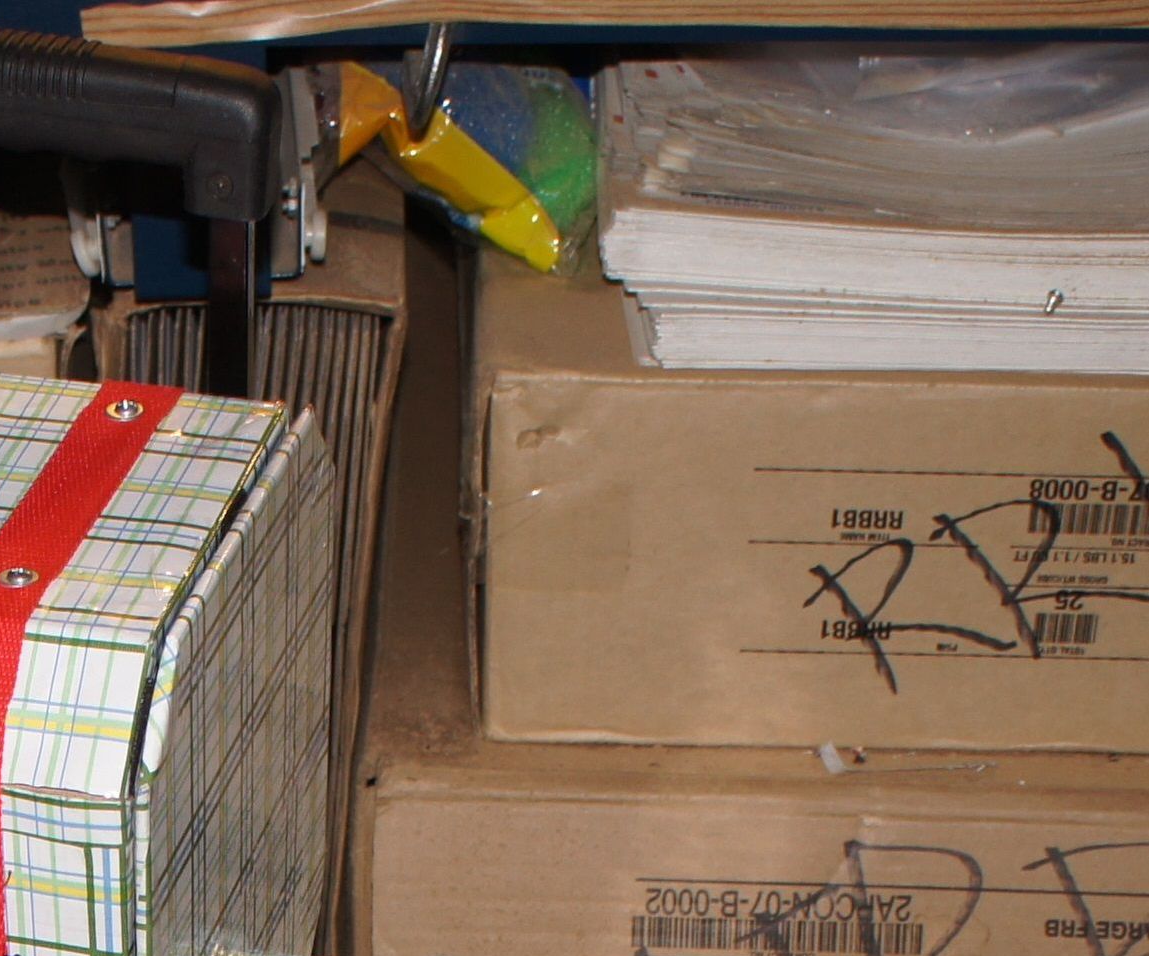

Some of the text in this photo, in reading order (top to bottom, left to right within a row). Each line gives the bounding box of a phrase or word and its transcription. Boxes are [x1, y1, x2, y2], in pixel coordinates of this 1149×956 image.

[831, 510, 904, 530] RRBB1
[1013, 551, 1029, 562] FT
[1051, 551, 1073, 562] 1.1
[1083, 551, 1108, 563] LBS
[1111, 552, 1136, 564] 15.1
[1055, 590, 1083, 611] 25
[821, 620, 892, 640] RRBB1
[1044, 919, 1088, 938] FRB
